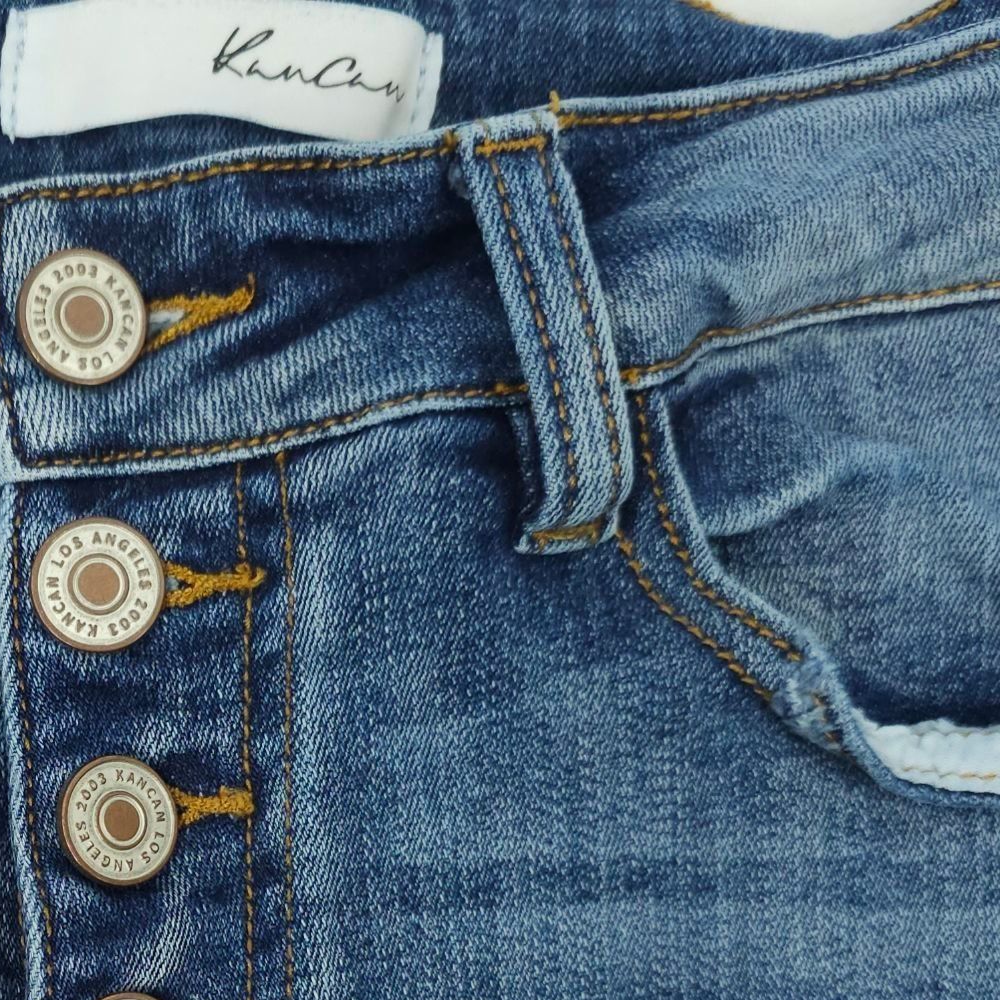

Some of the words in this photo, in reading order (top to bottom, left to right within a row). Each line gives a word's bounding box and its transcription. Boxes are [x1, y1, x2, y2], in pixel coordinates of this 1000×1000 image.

[52, 263, 98, 284] 2003
[105, 275, 134, 352] KANCAN
[78, 351, 114, 371] LOS
[51, 536, 83, 568] LOS
[92, 531, 152, 590] ANGELES
[46, 576, 98, 638] KANCAN
[107, 598, 148, 636] 2003
[75, 772, 107, 813] 2003
[115, 769, 166, 823] KANCAN
[75, 820, 134, 872] ANGELES
[140, 831, 165, 864] LOS
